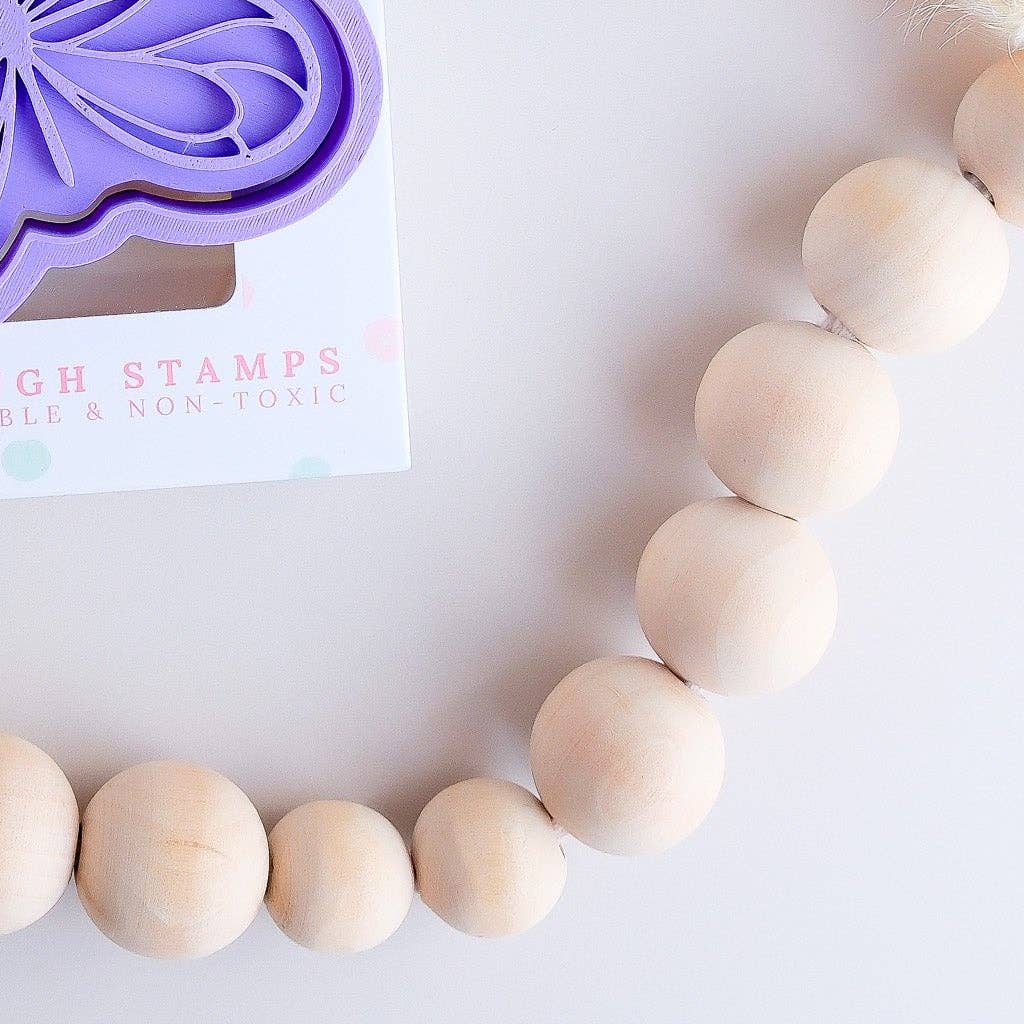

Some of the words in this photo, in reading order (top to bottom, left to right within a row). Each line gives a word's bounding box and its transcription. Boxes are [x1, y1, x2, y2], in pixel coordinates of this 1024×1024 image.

[124, 347, 343, 389] STAMPS
[87, 402, 104, 421] &
[129, 384, 348, 419] NON-TOXIC
